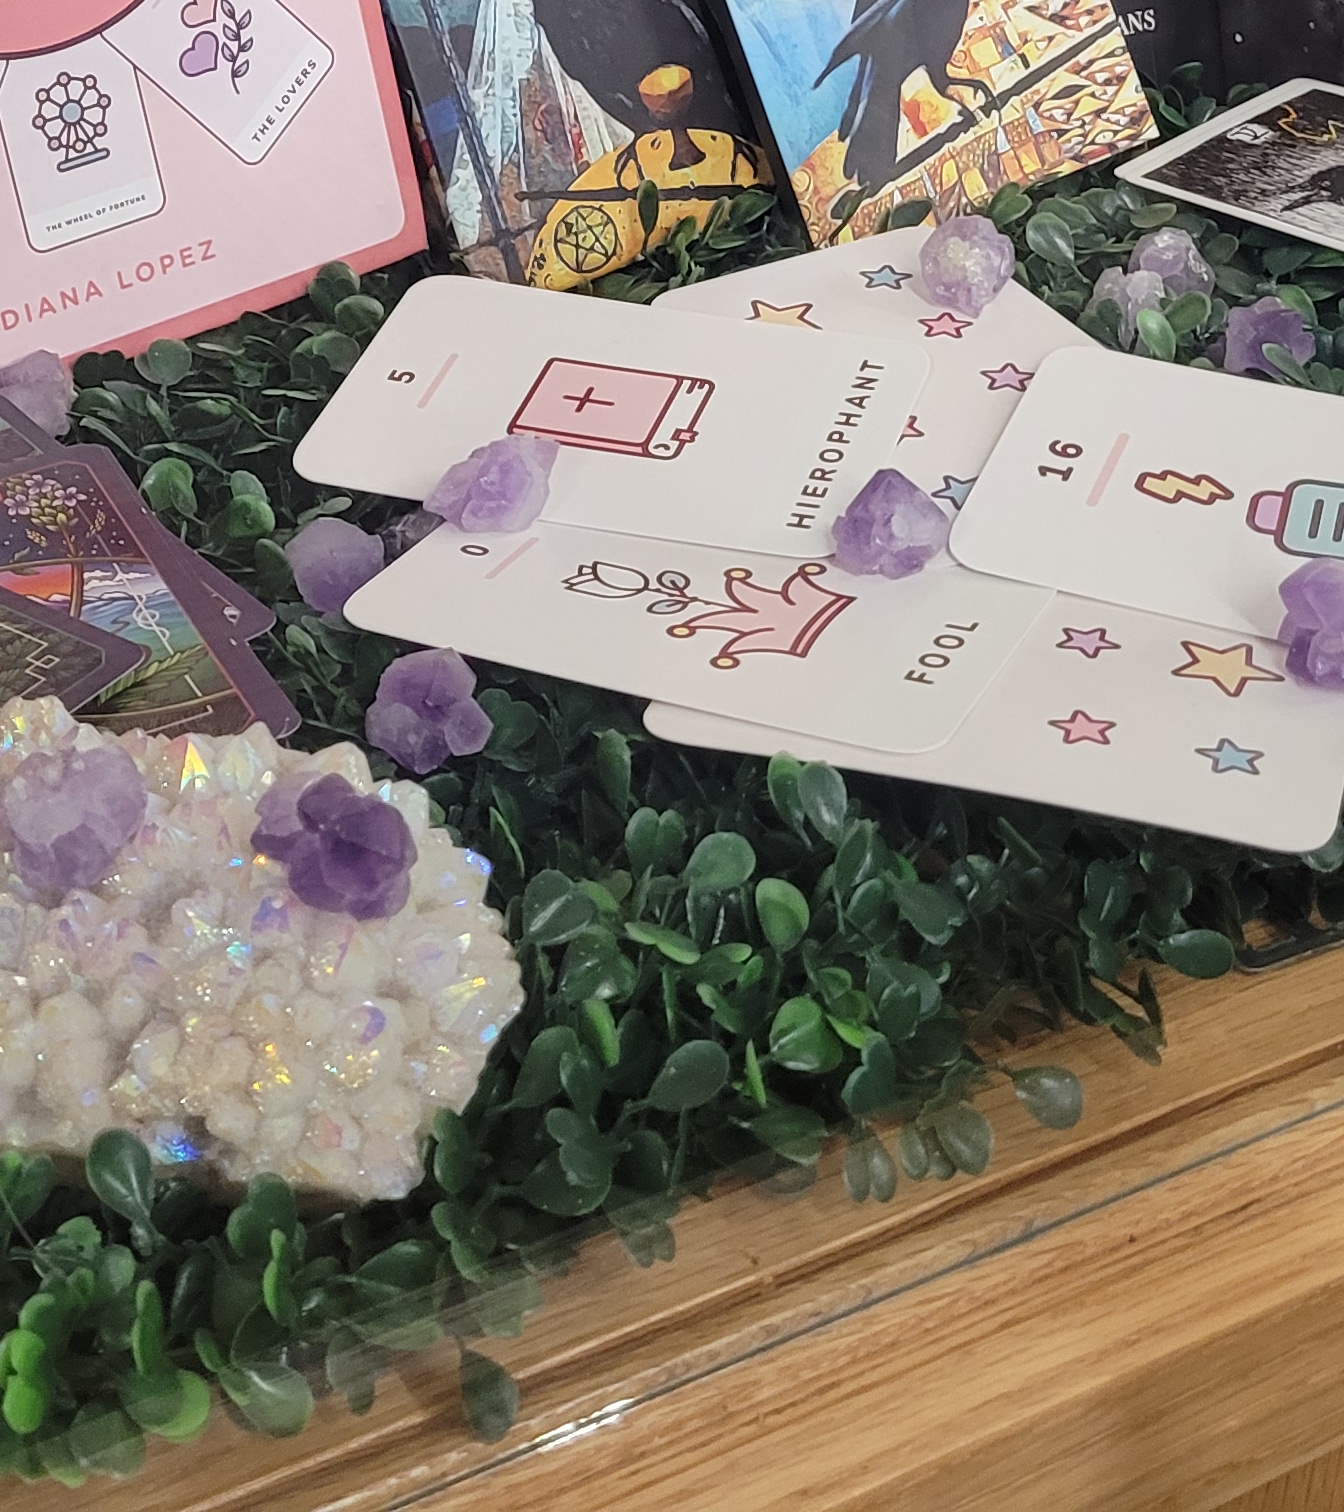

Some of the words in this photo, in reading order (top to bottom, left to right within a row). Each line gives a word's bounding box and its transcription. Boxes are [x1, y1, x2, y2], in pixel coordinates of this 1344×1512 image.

[1118, 9, 1155, 35] ANS
[251, 115, 277, 144] THE
[273, 57, 318, 118] LOVERS
[46, 222, 63, 232] THE
[65, 212, 93, 226] WHEEL
[96, 207, 107, 217] OF
[109, 194, 146, 211] FORTUNE
[0, 282, 104, 331] DIANA
[115, 239, 219, 291] LOPEZ
[387, 368, 416, 385] 5
[786, 359, 885, 530] HIEROPHANT
[1038, 439, 1084, 481] 16
[903, 620, 980, 685] FOOL
